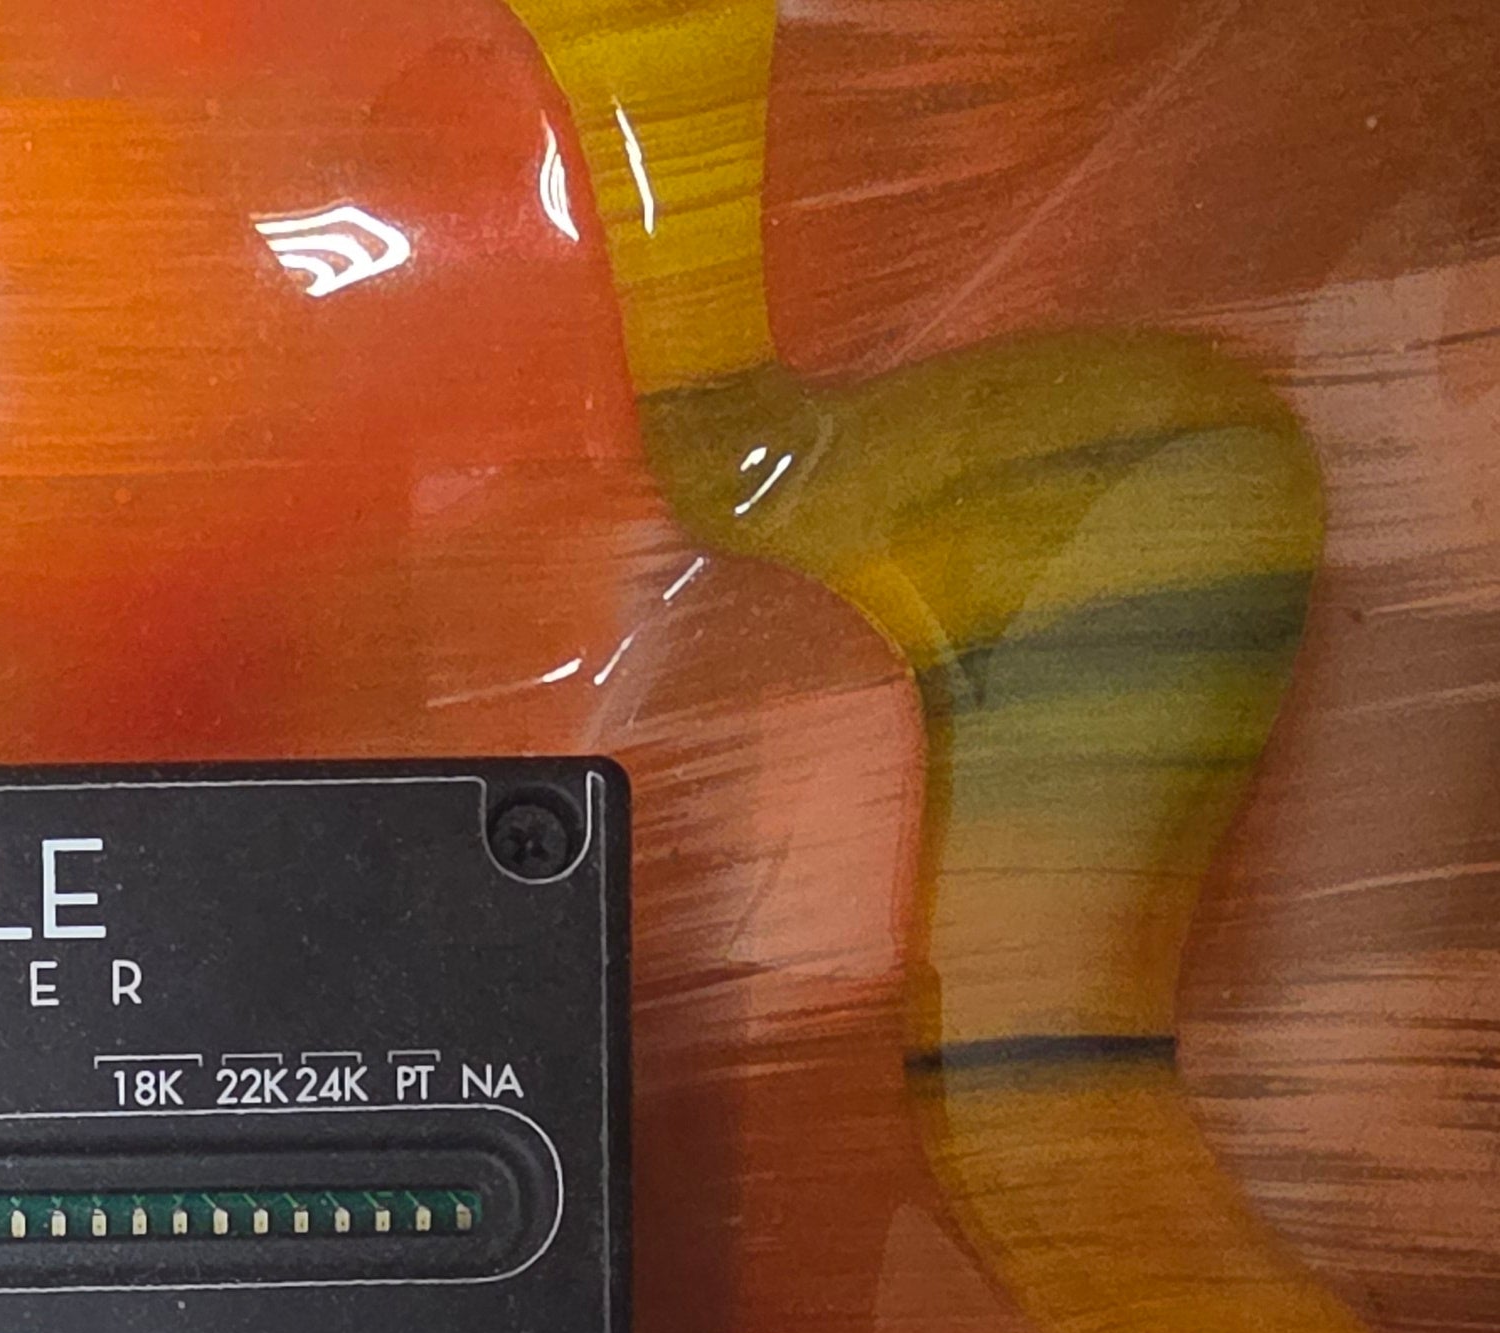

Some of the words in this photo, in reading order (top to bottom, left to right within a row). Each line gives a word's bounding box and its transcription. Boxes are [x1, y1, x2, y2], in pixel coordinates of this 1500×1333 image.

[114, 1069, 184, 1106] 18K
[216, 1067, 288, 1105] 22K
[295, 1066, 369, 1103] 24K
[396, 1065, 435, 1101] PT
[462, 1063, 524, 1099] NA
